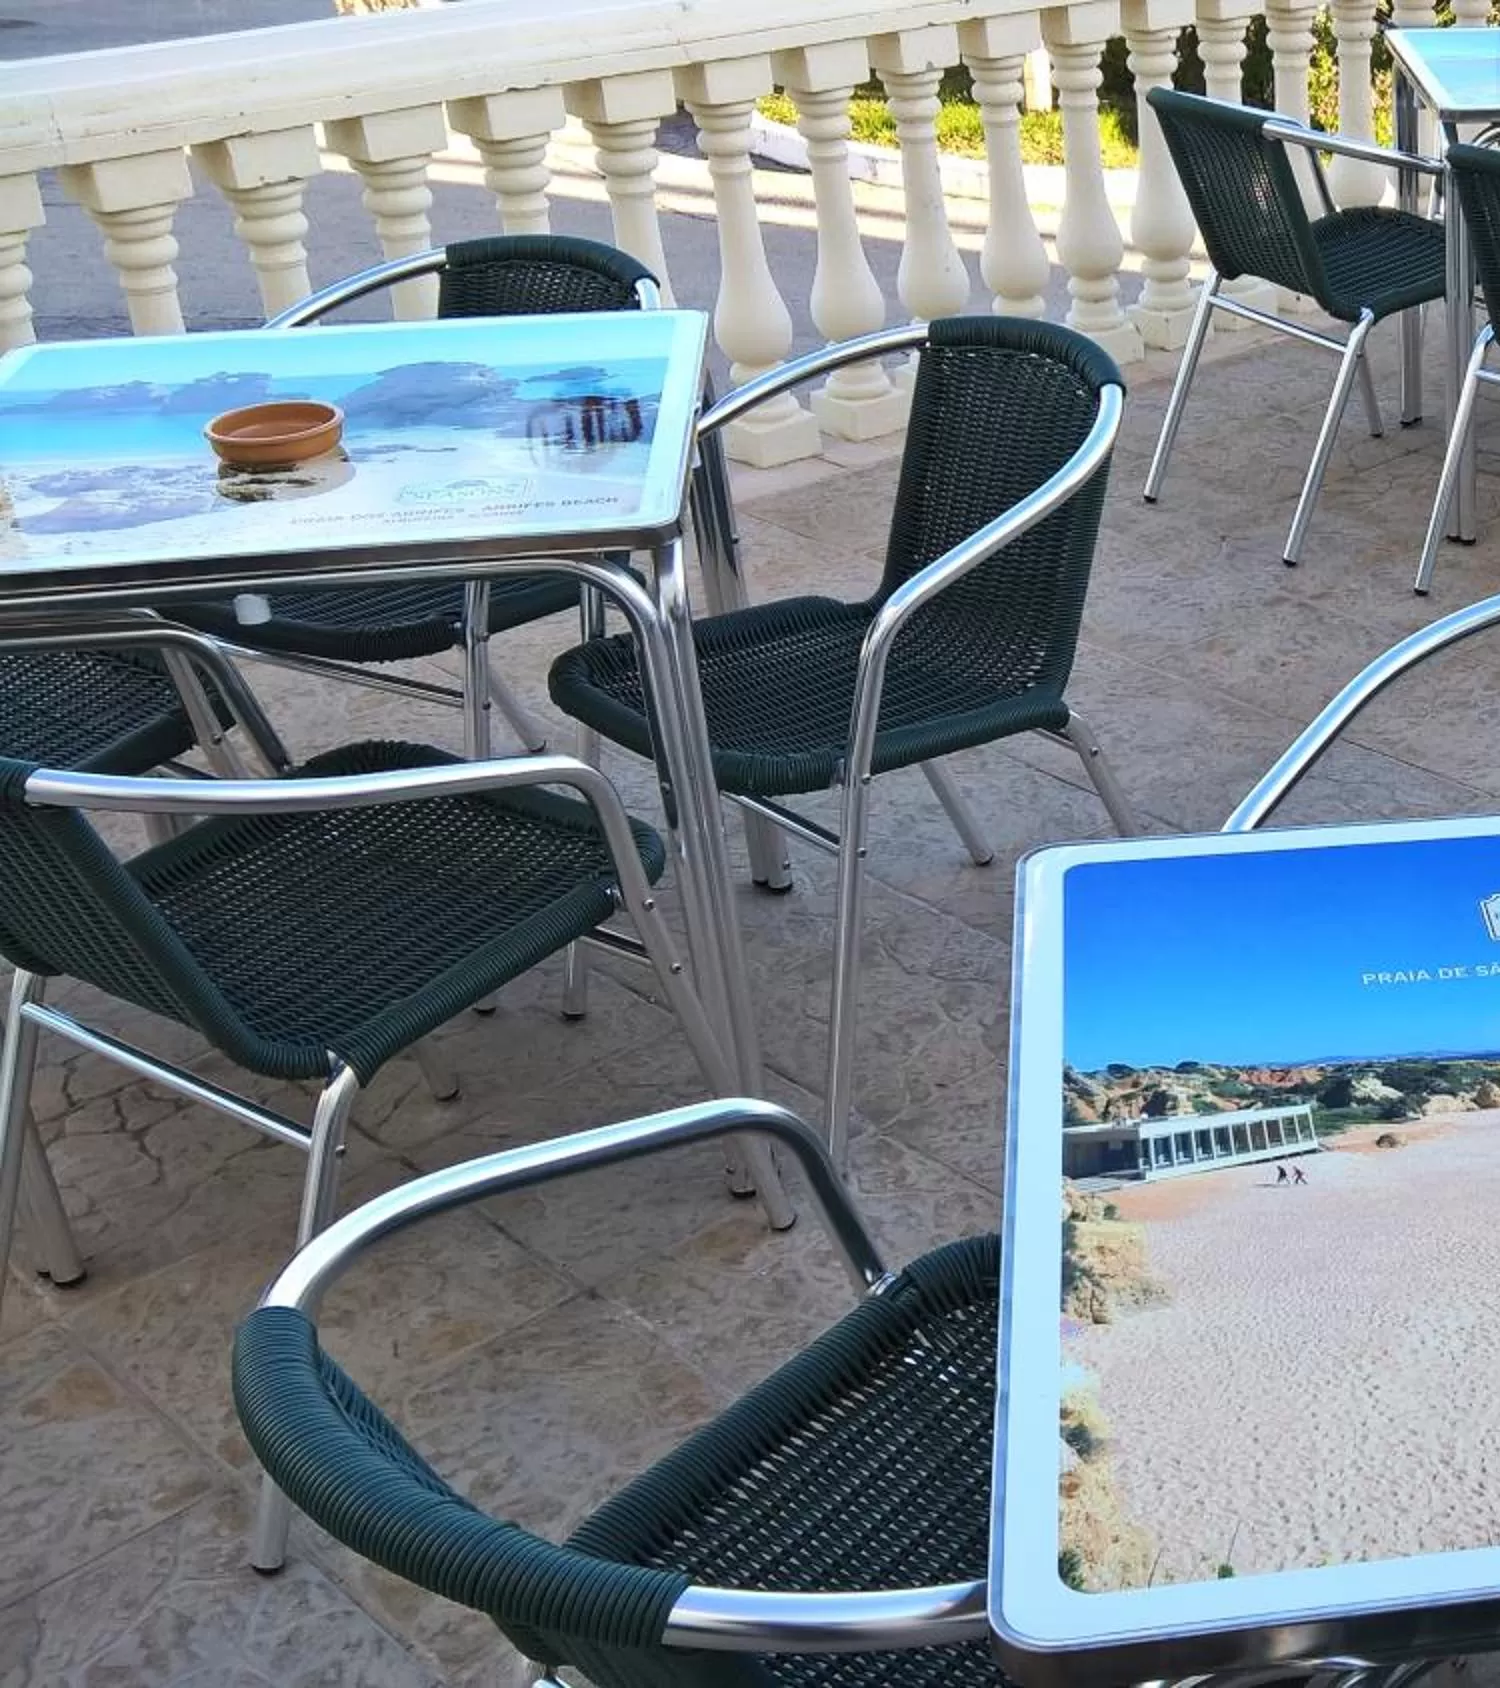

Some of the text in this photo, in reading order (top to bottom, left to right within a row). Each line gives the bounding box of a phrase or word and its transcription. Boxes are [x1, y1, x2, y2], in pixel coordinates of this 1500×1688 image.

[560, 495, 619, 507] BEACH
[1362, 967, 1432, 986] PRAIA
[1438, 965, 1470, 980] DE
